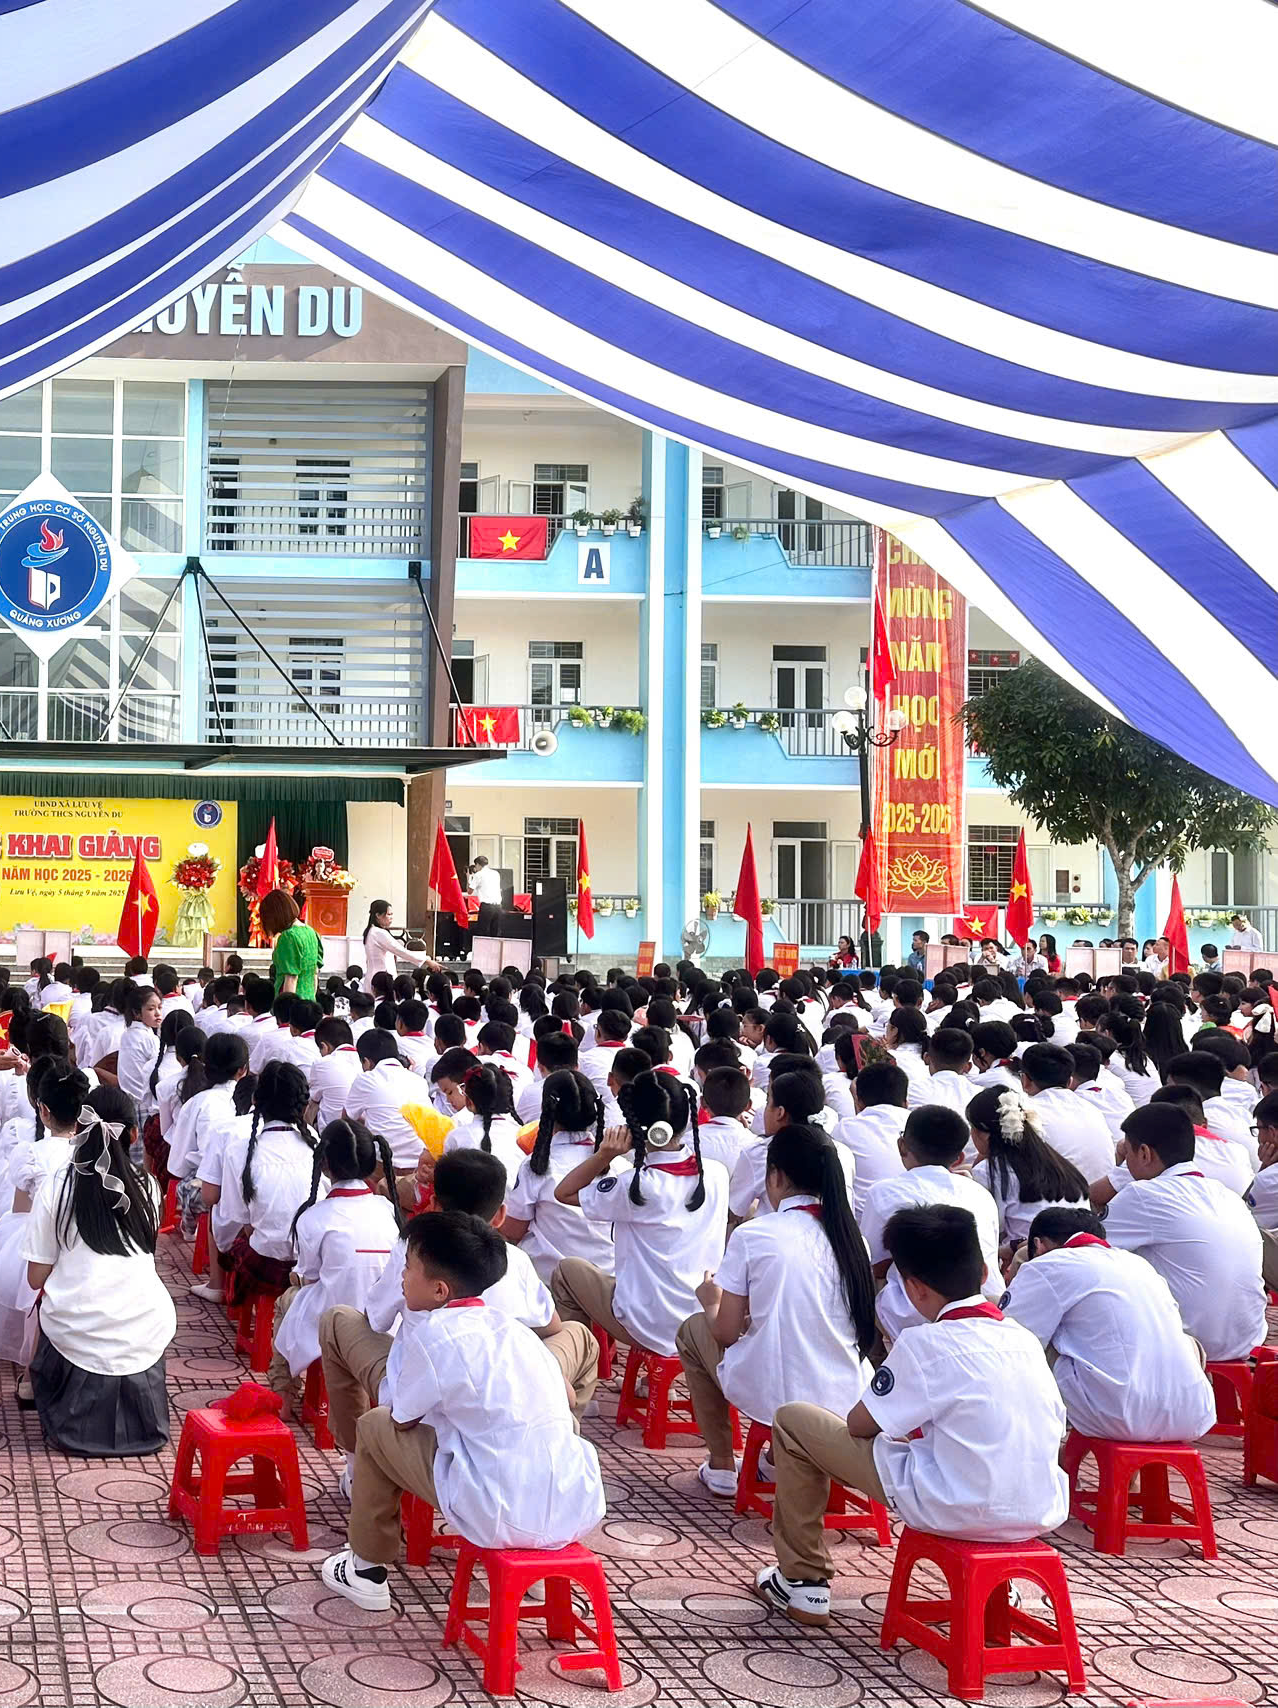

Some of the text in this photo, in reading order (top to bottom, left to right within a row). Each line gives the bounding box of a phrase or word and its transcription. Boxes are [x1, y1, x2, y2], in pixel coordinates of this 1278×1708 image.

[132, 264, 363, 337] UYỄN DU
[29, 503, 52, 513] HỌC
[55, 504, 71, 514] CƠ
[72, 511, 85, 523] SỞ
[99, 558, 108, 571] DU
[888, 534, 926, 565] CH
[583, 547, 604, 579] A
[10, 609, 81, 628] QUẢNG XƯƠNG
[894, 743, 940, 780] MỚI
[14, 808, 49, 817] TRƯỜNG
[51, 810, 73, 818] THCS
[34, 800, 57, 808] UBND
[58, 799, 72, 808] XÃ
[7, 833, 71, 857] KHAI
[78, 829, 160, 858] GIẢNG
[2, 866, 30, 881] NĂM
[34, 868, 58, 884] HỌC
[62, 869, 92, 882] 2025
[104, 869, 132, 882] 2026
